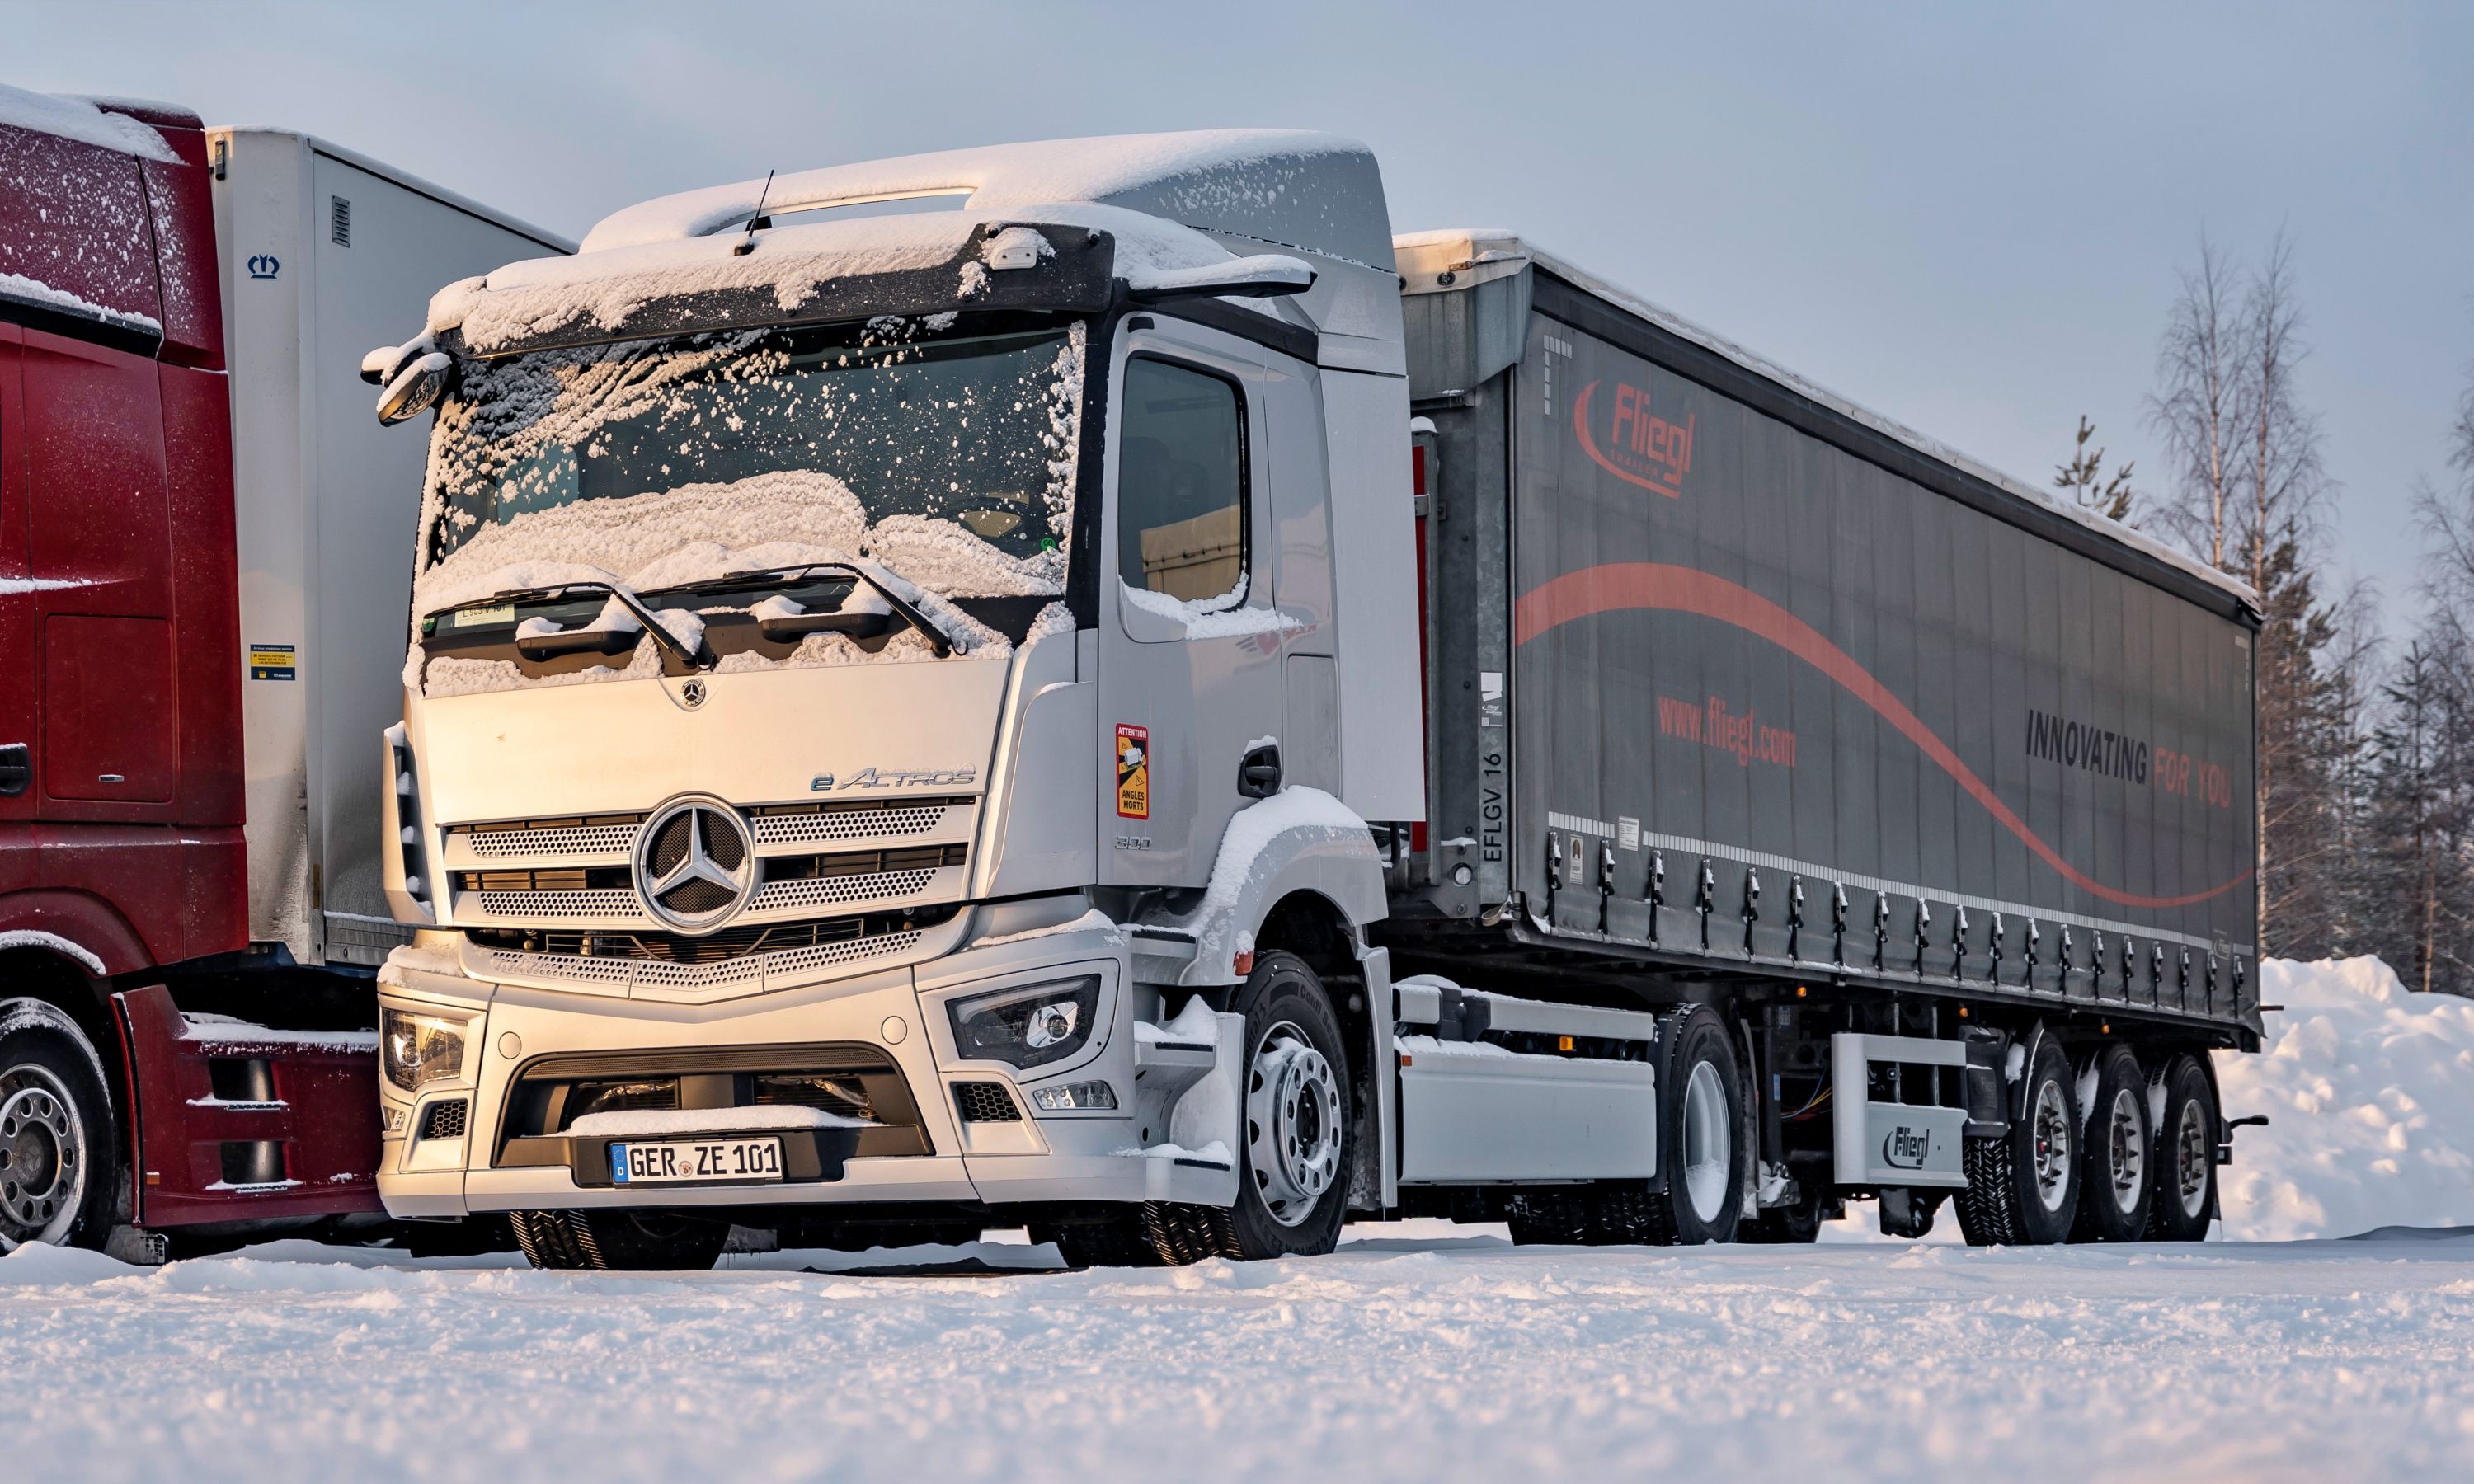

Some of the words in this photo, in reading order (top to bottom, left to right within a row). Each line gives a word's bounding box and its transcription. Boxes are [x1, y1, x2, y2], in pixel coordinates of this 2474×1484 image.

[1611, 382, 1696, 486] Fliegl
[1117, 726, 1147, 739] ATTENTION
[1658, 695, 1795, 768] www.fliegl.com
[1484, 753, 1502, 777] 16
[2026, 709, 2147, 785] INNOVATING
[2153, 747, 2190, 797] FOR
[2198, 759, 2233, 810] YOU
[811, 776, 835, 791] e
[1122, 789, 1145, 801] ANGLES
[1123, 800, 1144, 811] MORTS
[1484, 788, 1503, 862] EFLGV
[1115, 835, 1152, 851] 300
[1894, 1126, 1930, 1166] Fliegl
[618, 1167, 624, 1176] D
[629, 1148, 677, 1177] GER
[694, 1146, 727, 1175] ZE
[732, 1144, 780, 1174] 101
